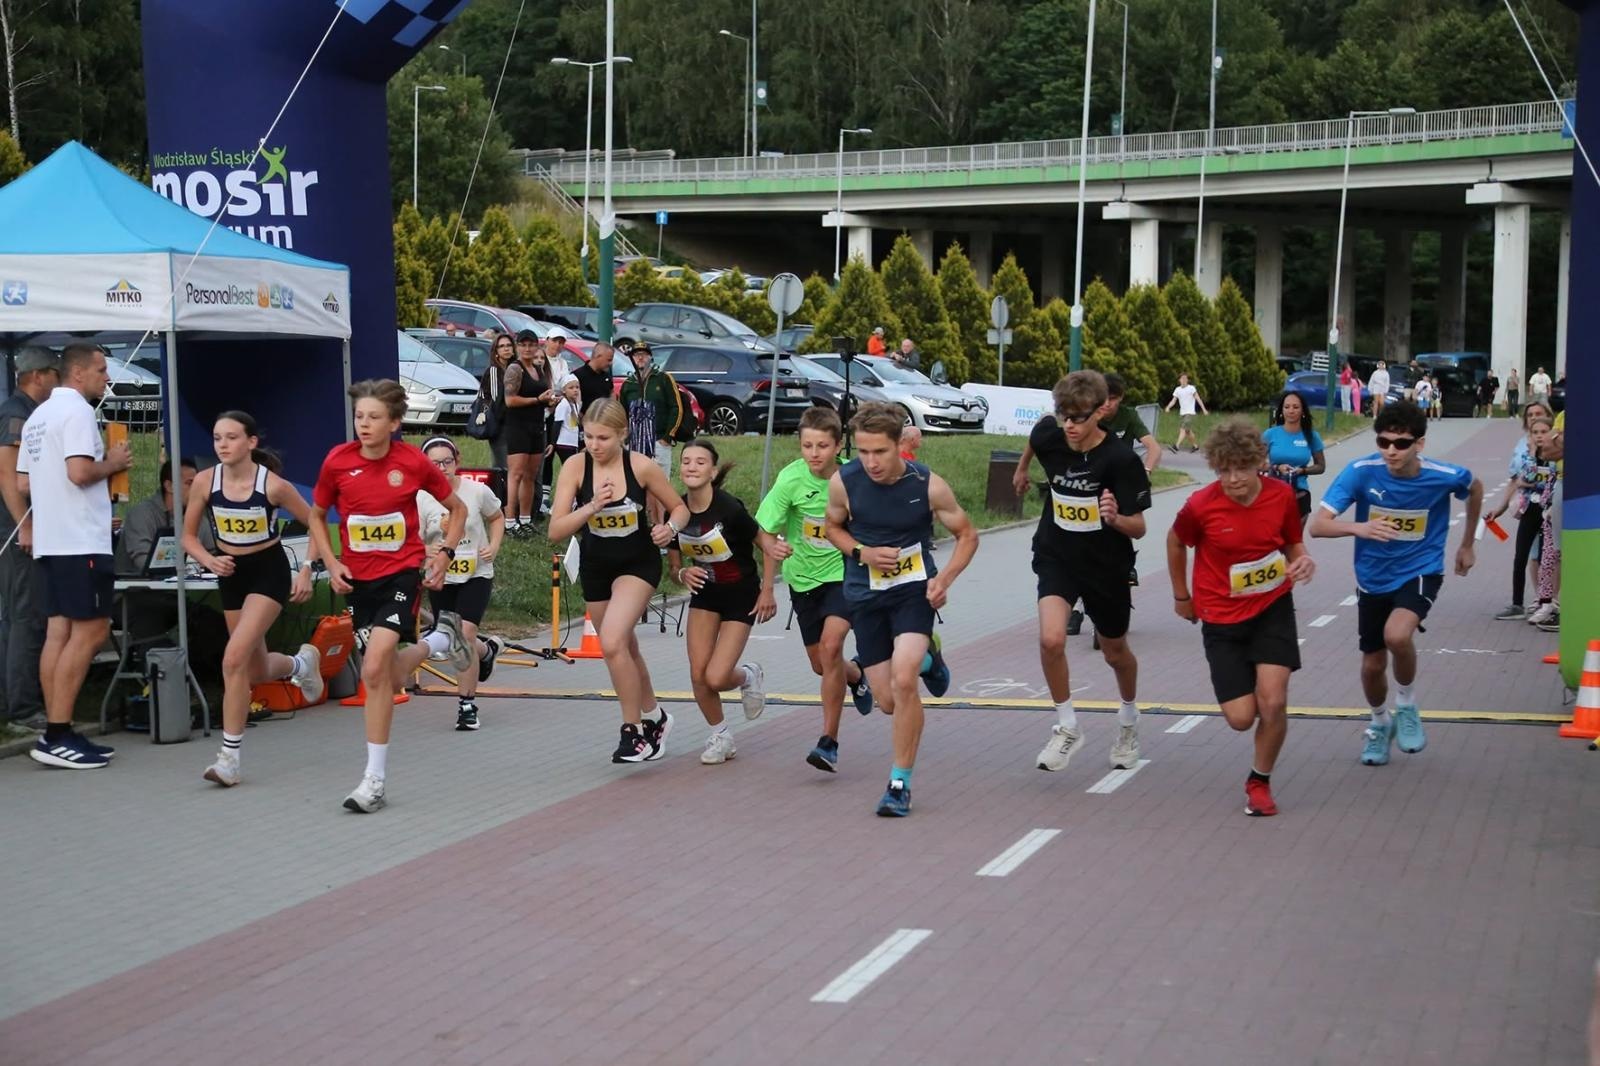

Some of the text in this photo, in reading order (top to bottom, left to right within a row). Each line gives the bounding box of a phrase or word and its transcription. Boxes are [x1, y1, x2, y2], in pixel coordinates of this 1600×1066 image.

[153, 146, 256, 169] Wodzisław Śląski
[106, 291, 142, 303] MITKO
[185, 282, 255, 305] PersonalBest
[1057, 503, 1090, 521] 130
[223, 518, 258, 533] 132
[595, 515, 629, 529] 131
[1386, 516, 1416, 532] 35
[359, 524, 396, 541] 144
[692, 544, 714, 556] 50
[447, 560, 470, 574] 43
[1242, 564, 1278, 588] 136
